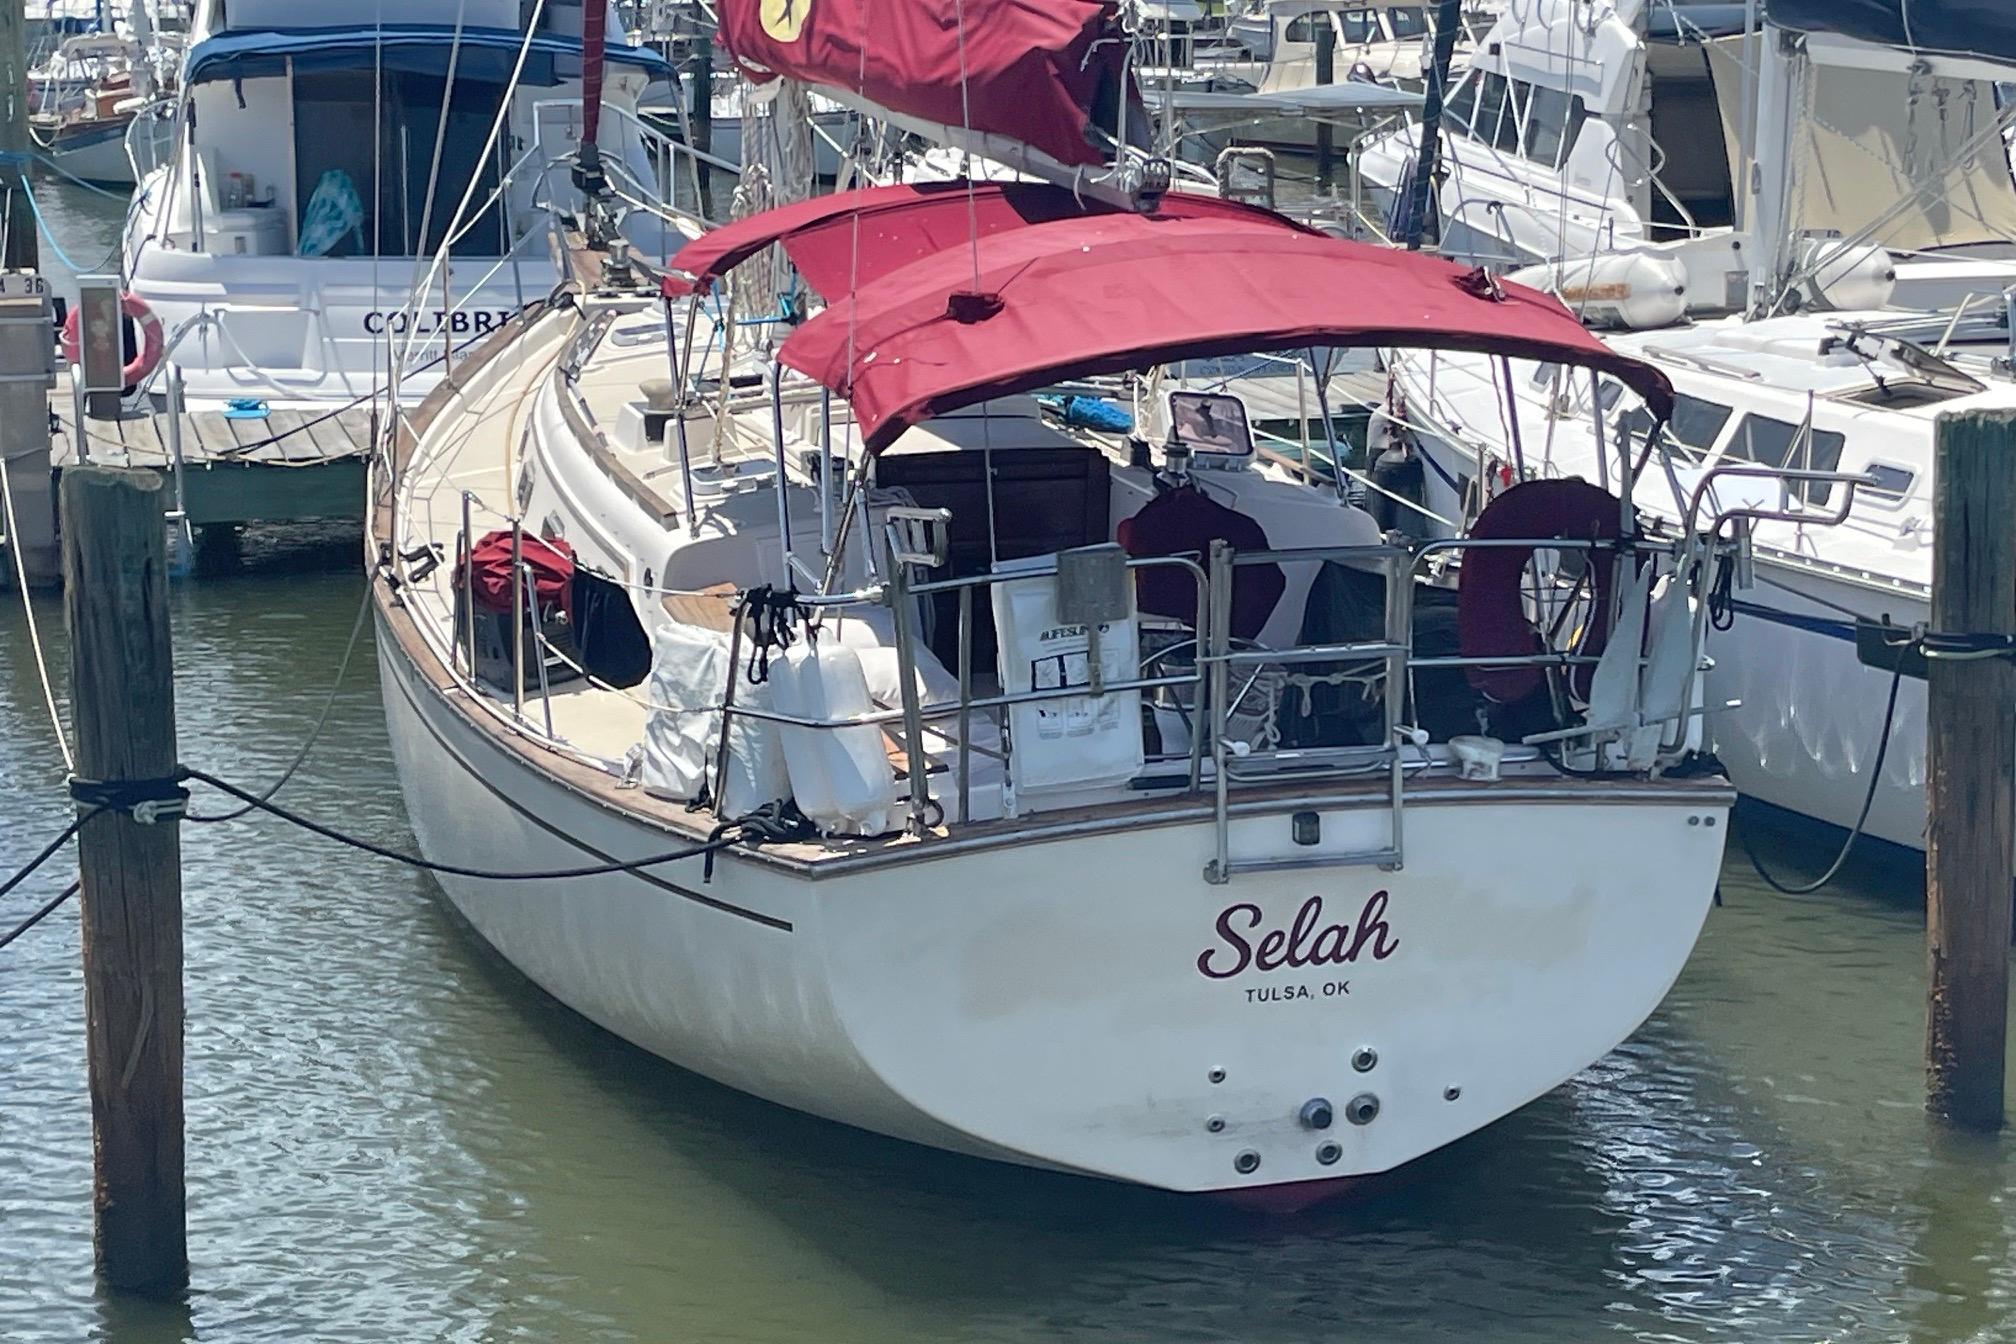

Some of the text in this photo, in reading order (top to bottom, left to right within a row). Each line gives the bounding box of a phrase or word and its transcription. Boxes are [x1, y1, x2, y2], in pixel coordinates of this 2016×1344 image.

[24, 277, 44, 294] 36
[363, 310, 511, 335] COLIBRI
[1197, 889, 1400, 979] Selah
[1245, 980, 1351, 1003] TULSA, OK
